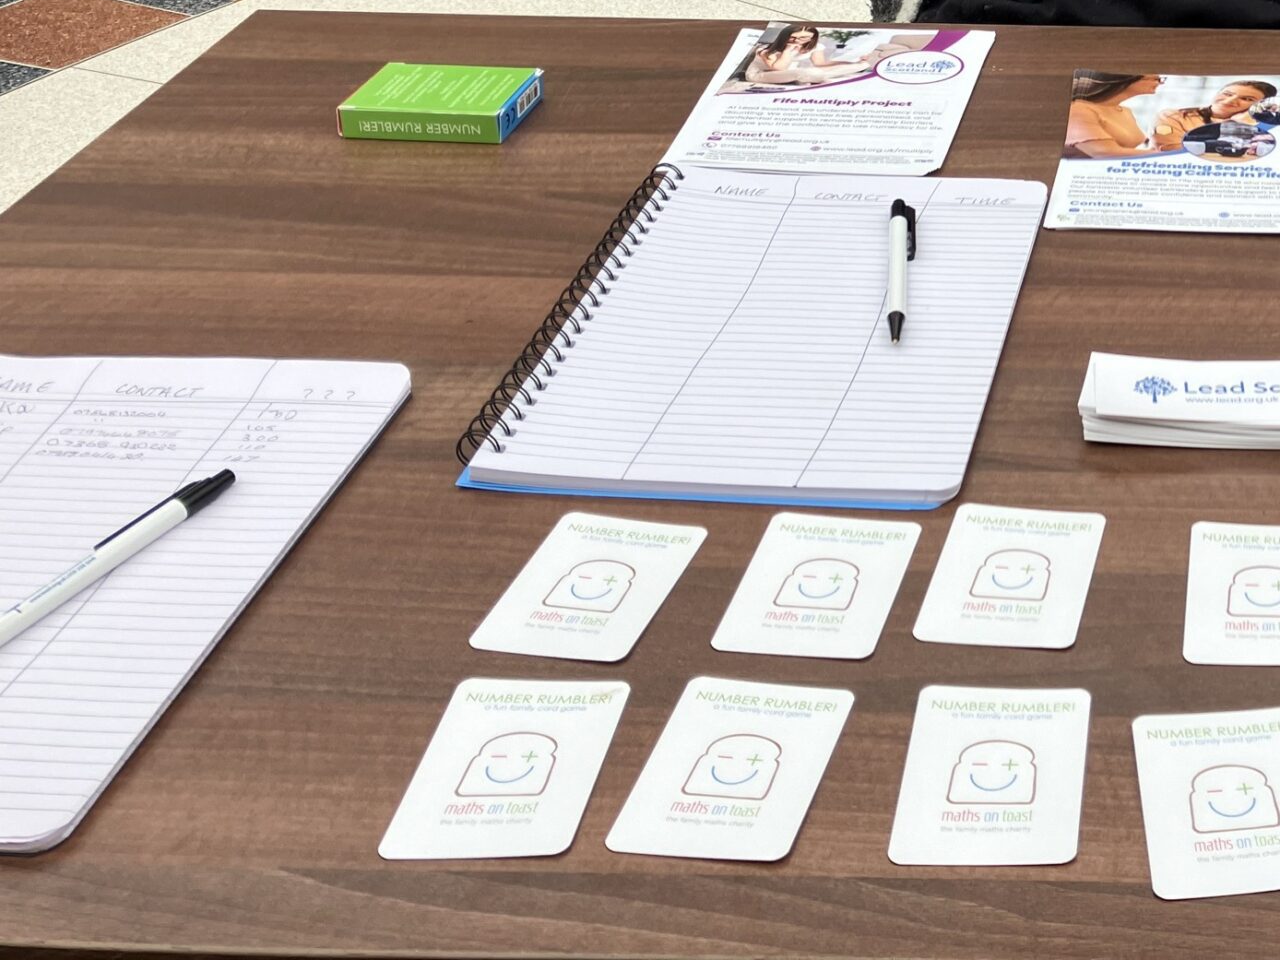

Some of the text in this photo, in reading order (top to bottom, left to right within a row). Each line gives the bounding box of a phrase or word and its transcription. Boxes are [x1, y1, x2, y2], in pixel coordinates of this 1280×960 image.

[799, 98, 860, 107] Multiply
[861, 99, 912, 107] Project
[359, 120, 481, 135] NUMBER RUMBLER!
[1121, 161, 1273, 172] Befriending Service
[1132, 167, 1182, 177] Young
[715, 185, 769, 197] NAME
[814, 191, 888, 202] CONTACT
[1070, 200, 1124, 208] Contact
[116, 383, 204, 398] CONTACT
[1184, 381, 1245, 394] Lead
[1185, 395, 1279, 404] www.lead.org.uk
[966, 514, 1092, 532] NUMBER RUMBLER!
[567, 523, 691, 545] NUMBER RUMBLER!
[779, 523, 906, 541] NUMBER RUMBLER!
[1202, 532, 1260, 545] NUMBER
[963, 600, 1043, 616] maths on toast
[530, 610, 609, 627] maths on toast
[764, 610, 845, 625] maths on toast
[1225, 620, 1260, 632] maths
[1262, 622, 1276, 632] on
[465, 692, 613, 705] NUMBER RUMBLER!
[695, 690, 838, 712] NUMBER RUMBLER!
[931, 699, 1076, 713] NUMBER RUMBLER!
[1146, 727, 1212, 741] NUMBER
[444, 801, 539, 815] maths on toast
[670, 800, 761, 818] maths on toast
[941, 809, 1033, 823] maths on toast
[1194, 837, 1234, 853] maths
[1236, 838, 1252, 849] on
